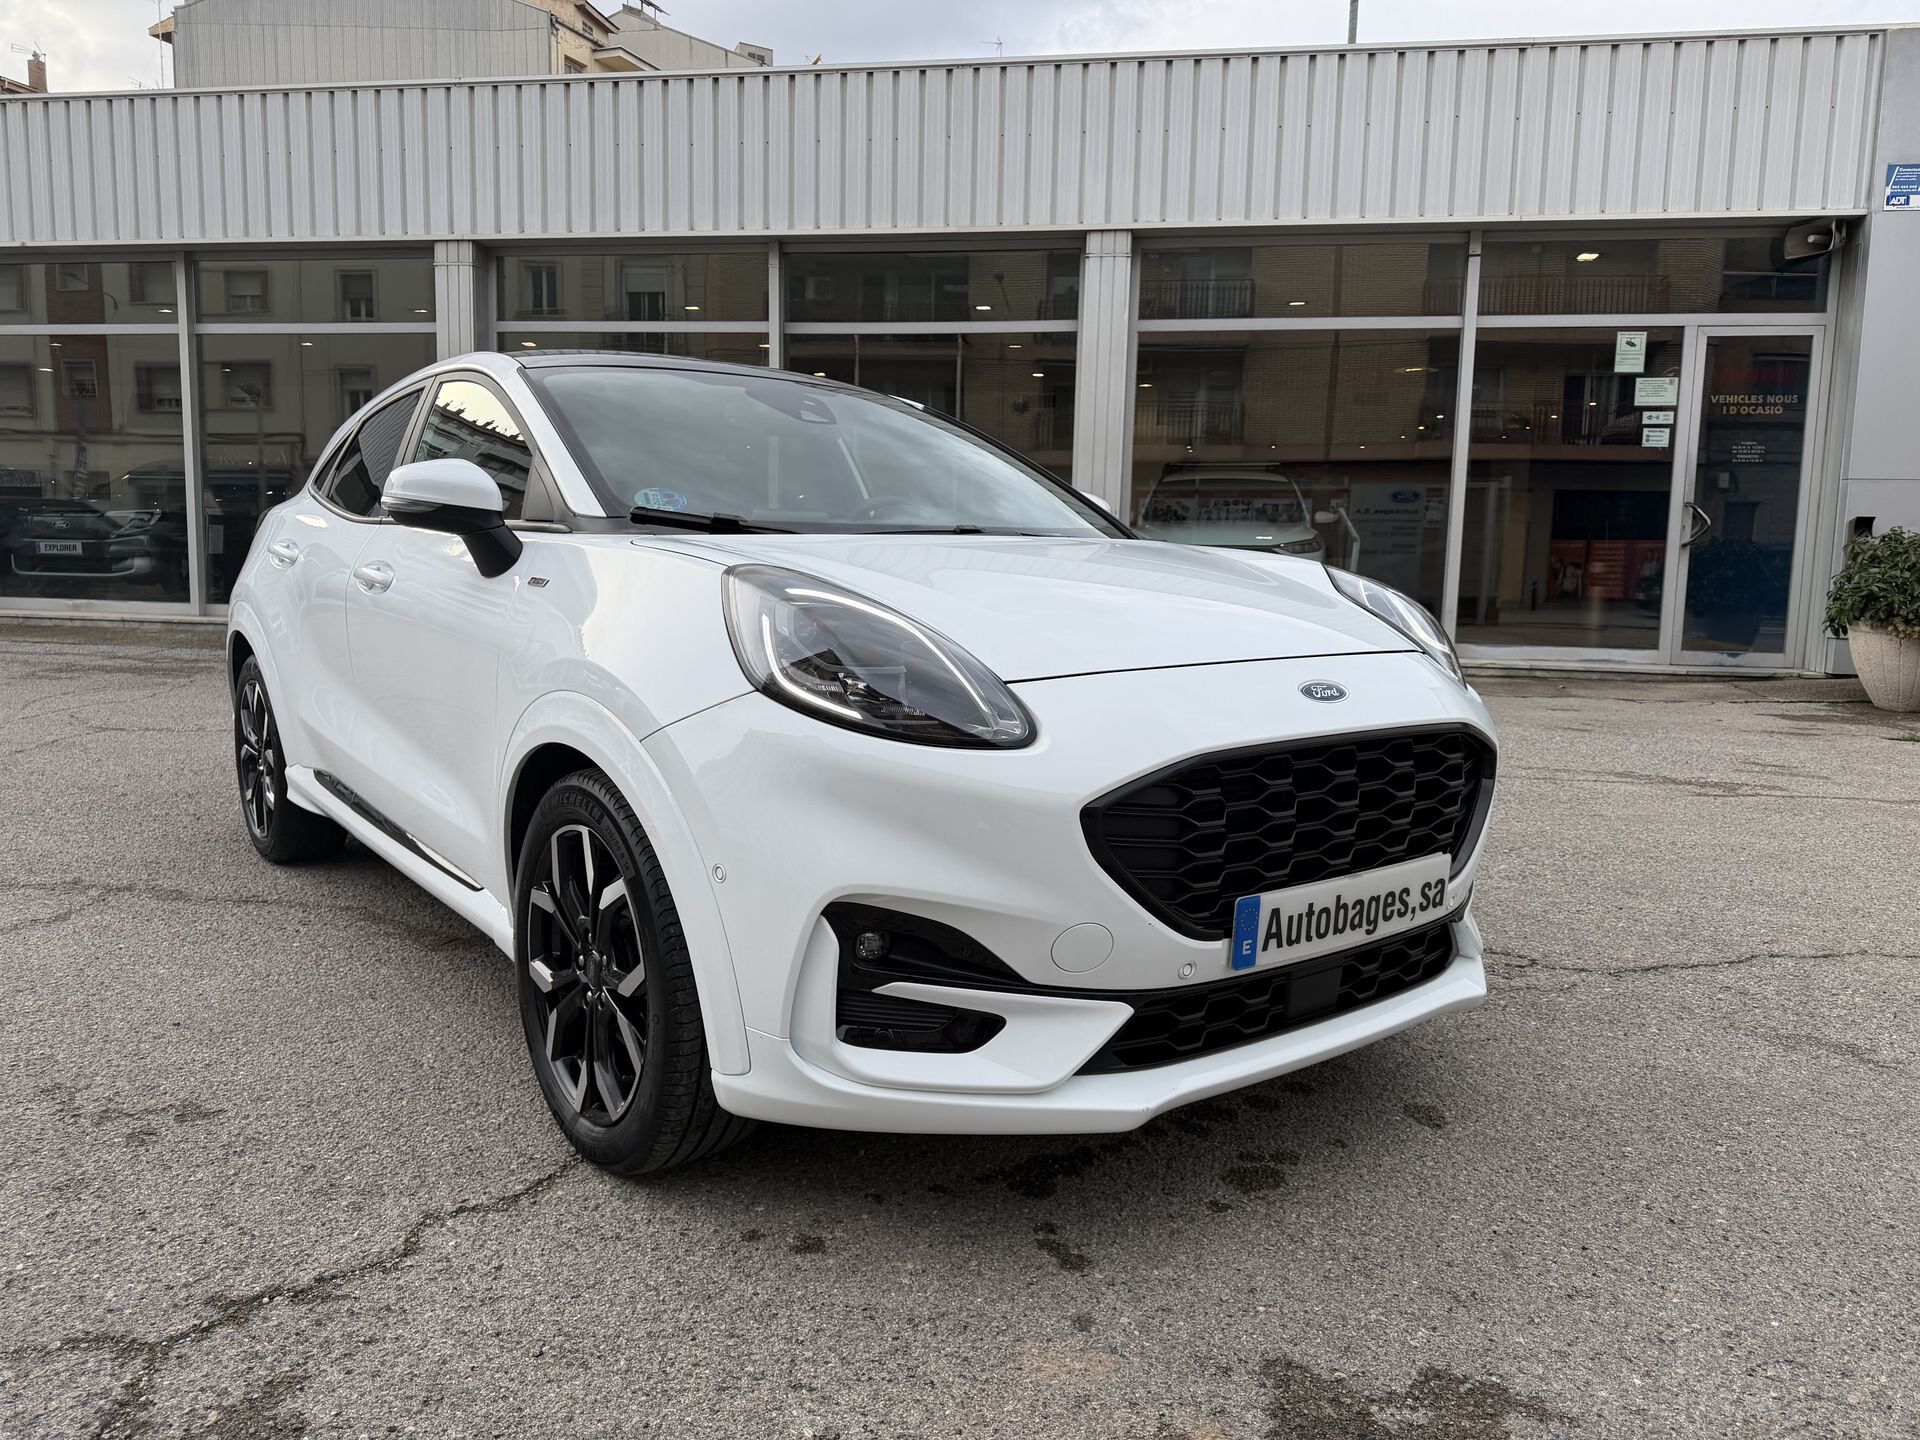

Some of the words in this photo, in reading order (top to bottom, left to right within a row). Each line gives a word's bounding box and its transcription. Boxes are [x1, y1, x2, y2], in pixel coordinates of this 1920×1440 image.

[1889, 196, 1907, 205] ADT
[1710, 394, 1764, 404] VEHICLES
[1766, 394, 1799, 404] NOUS
[1722, 405, 1727, 415] I
[1729, 404, 1784, 415] D'OCASIÓ
[44, 543, 77, 552] EXPLORER
[1310, 685, 1340, 698] Ford
[1261, 877, 1447, 953] Autobages,sa
[1242, 939, 1252, 956] E
